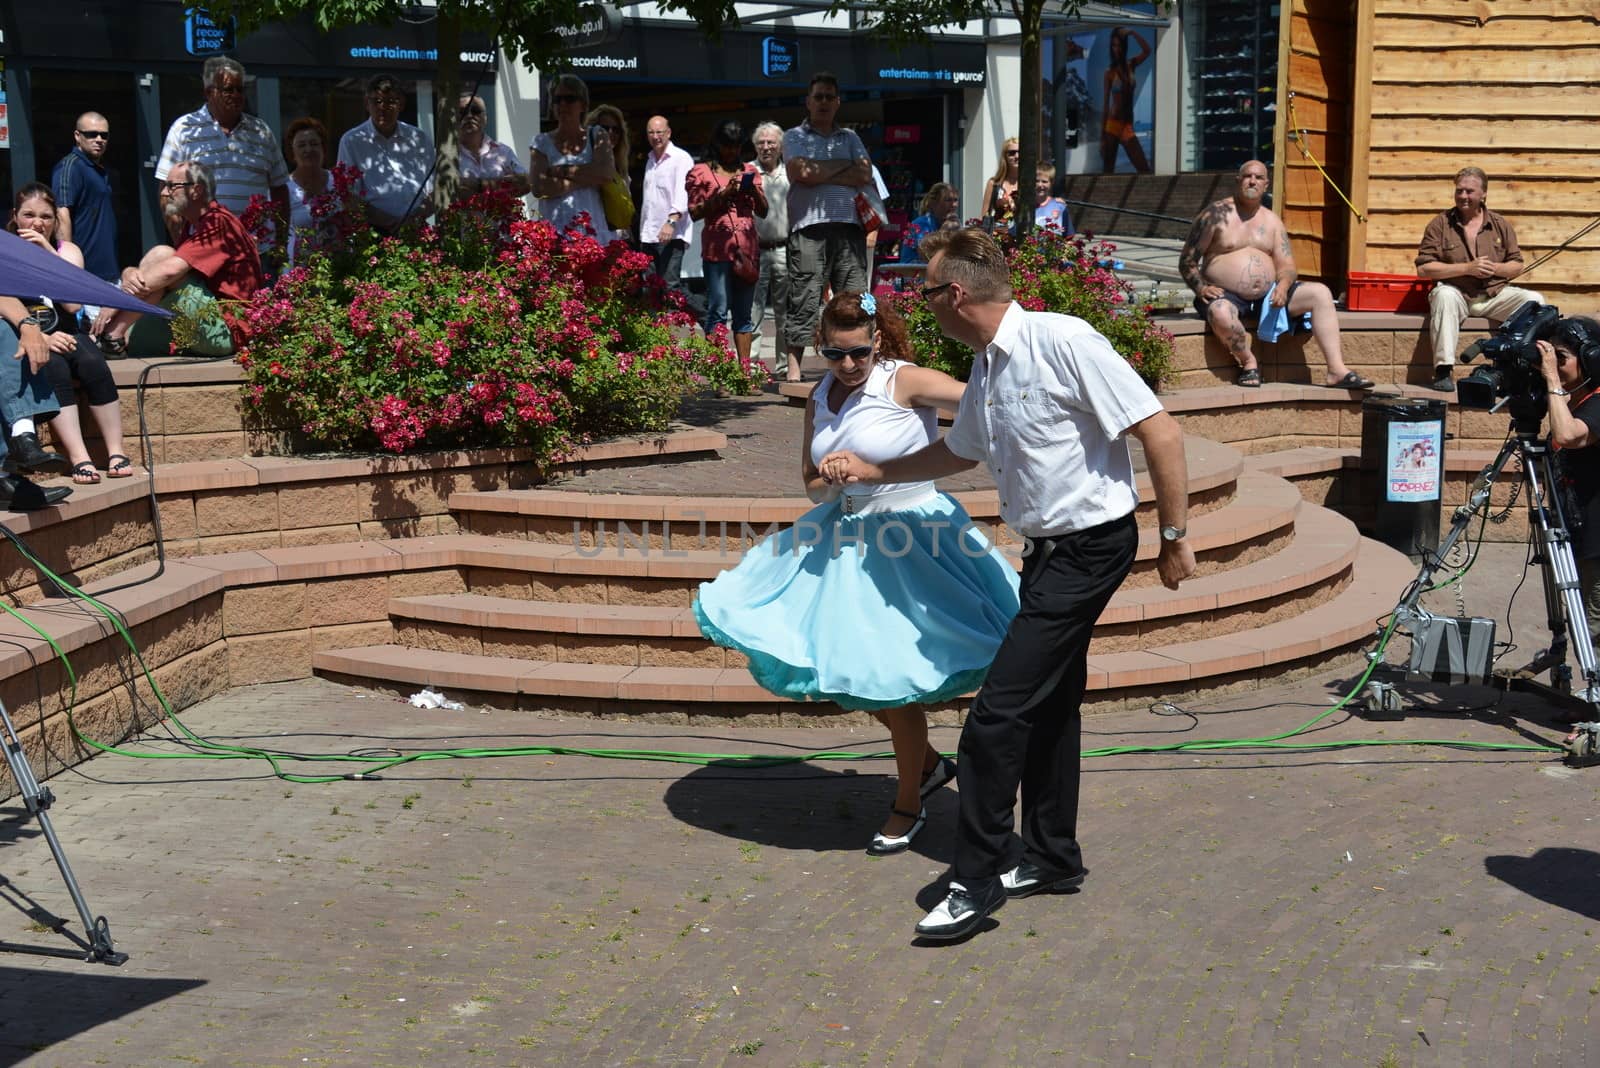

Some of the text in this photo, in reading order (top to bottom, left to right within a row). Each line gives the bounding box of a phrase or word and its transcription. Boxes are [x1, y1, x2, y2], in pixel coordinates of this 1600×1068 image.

[197, 38, 221, 49] shop
[350, 46, 438, 60] entertainment
[771, 63, 789, 73] shop
[879, 68, 942, 80] entertainment
[944, 69, 952, 80] is
